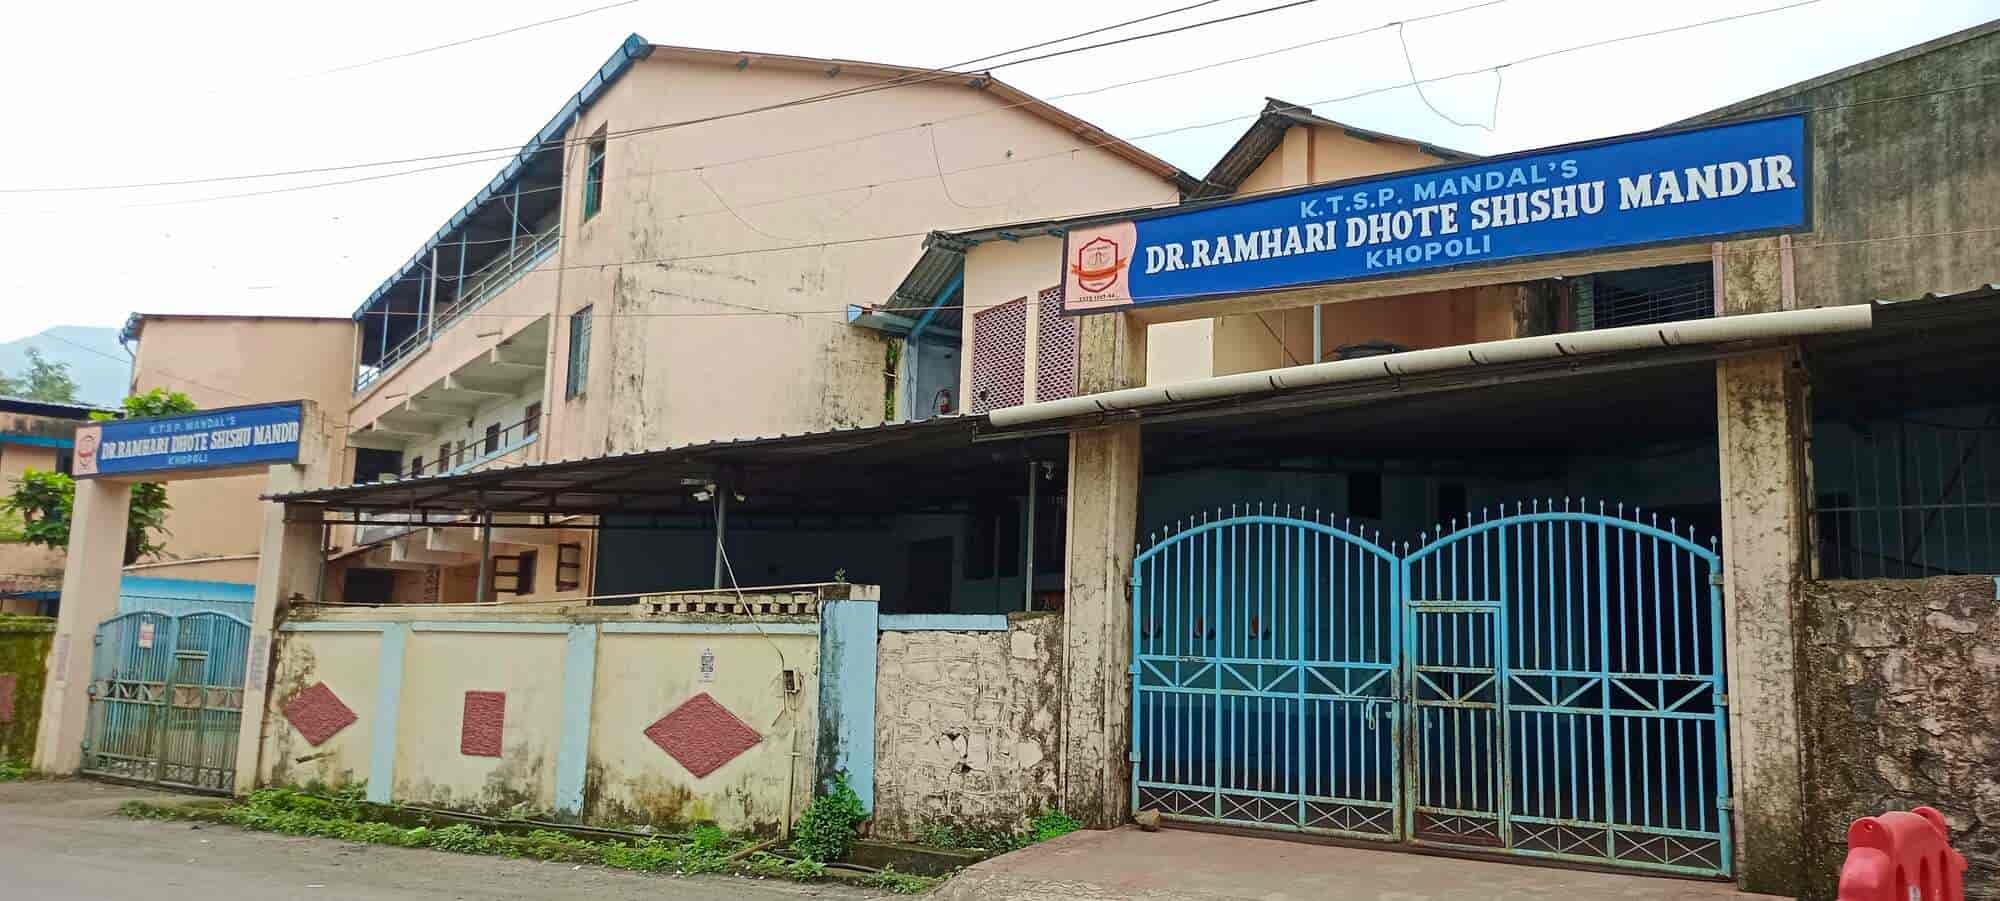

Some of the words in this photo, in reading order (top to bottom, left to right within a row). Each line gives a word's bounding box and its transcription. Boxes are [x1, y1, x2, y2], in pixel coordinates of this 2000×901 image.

[1145, 220, 1337, 274] DR.RAMHARI
[1346, 202, 1459, 247] DHOTE
[1470, 181, 1605, 230] SHISHU
[1618, 154, 1796, 210] MANDIR
[1300, 188, 1403, 218] K.T.S.P.
[1366, 235, 1491, 269] KHOPOLI
[171, 433, 208, 452] DHOTE
[209, 426, 252, 450] SHISHU
[254, 421, 299, 445] MANDIR
